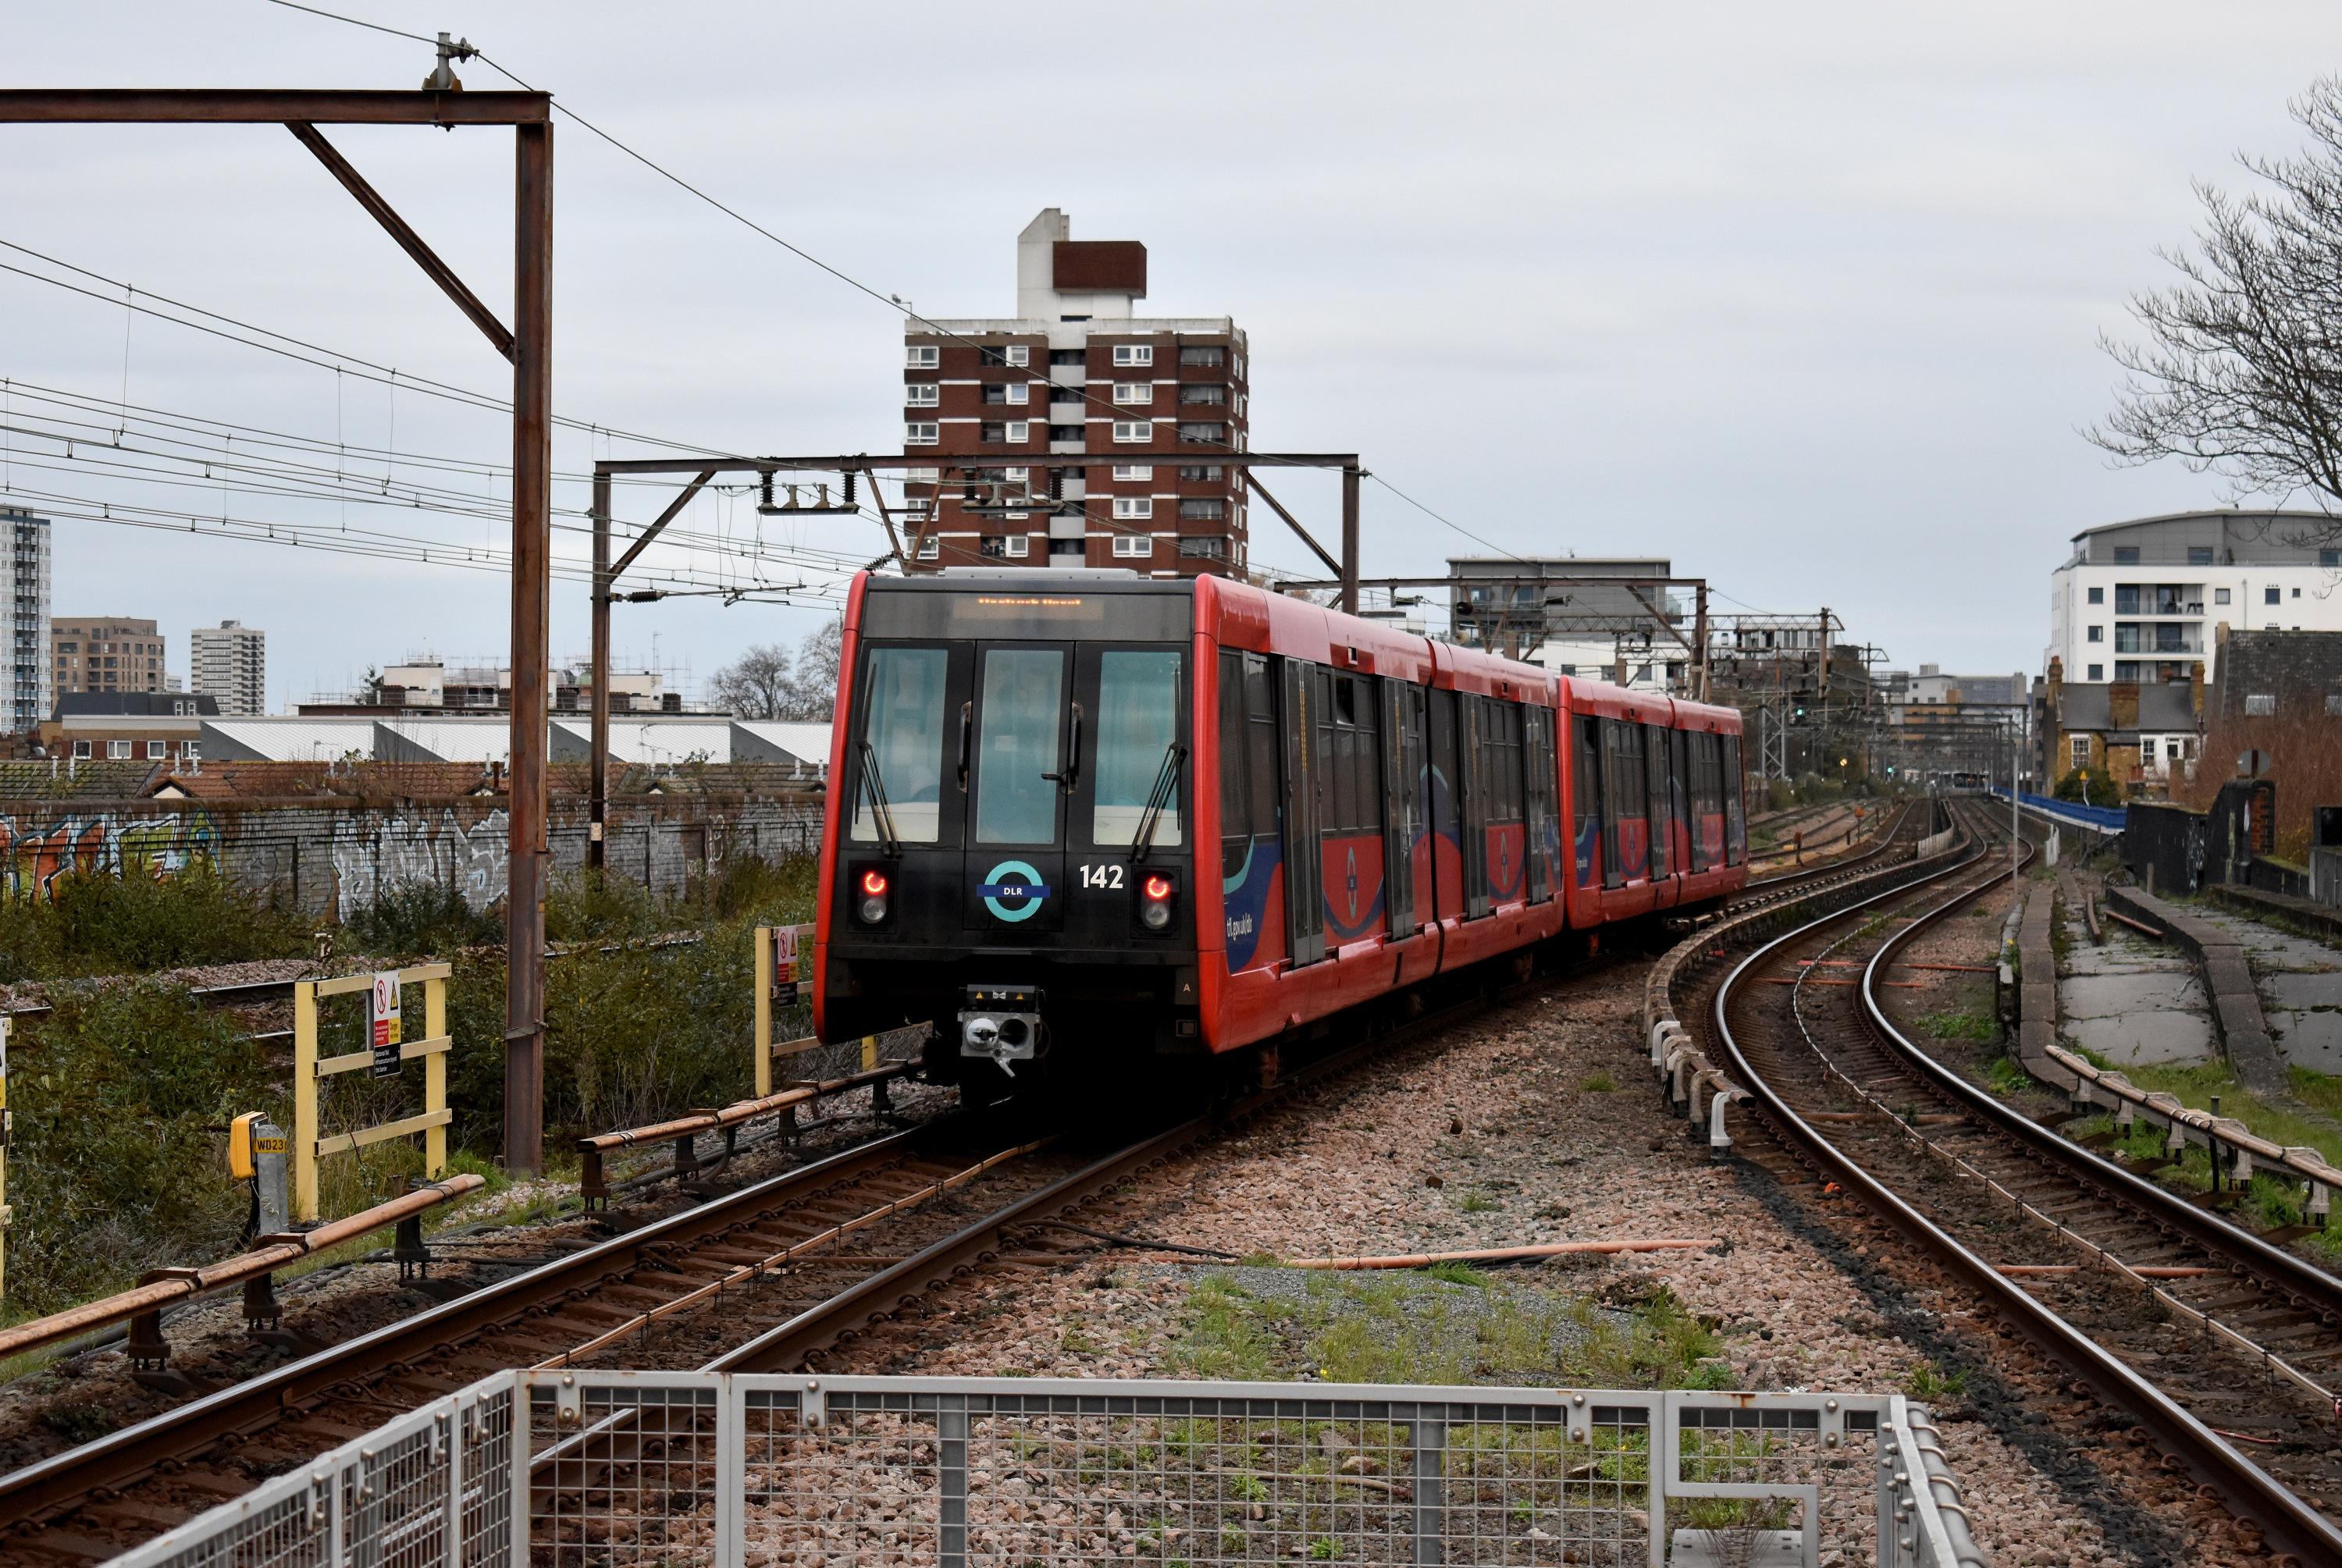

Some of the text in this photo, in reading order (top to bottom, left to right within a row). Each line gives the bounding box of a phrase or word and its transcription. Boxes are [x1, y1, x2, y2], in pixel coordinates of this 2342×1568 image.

[1080, 865, 1123, 889] 142
[1004, 887, 1023, 896] DLR
[1183, 983, 1191, 992] A
